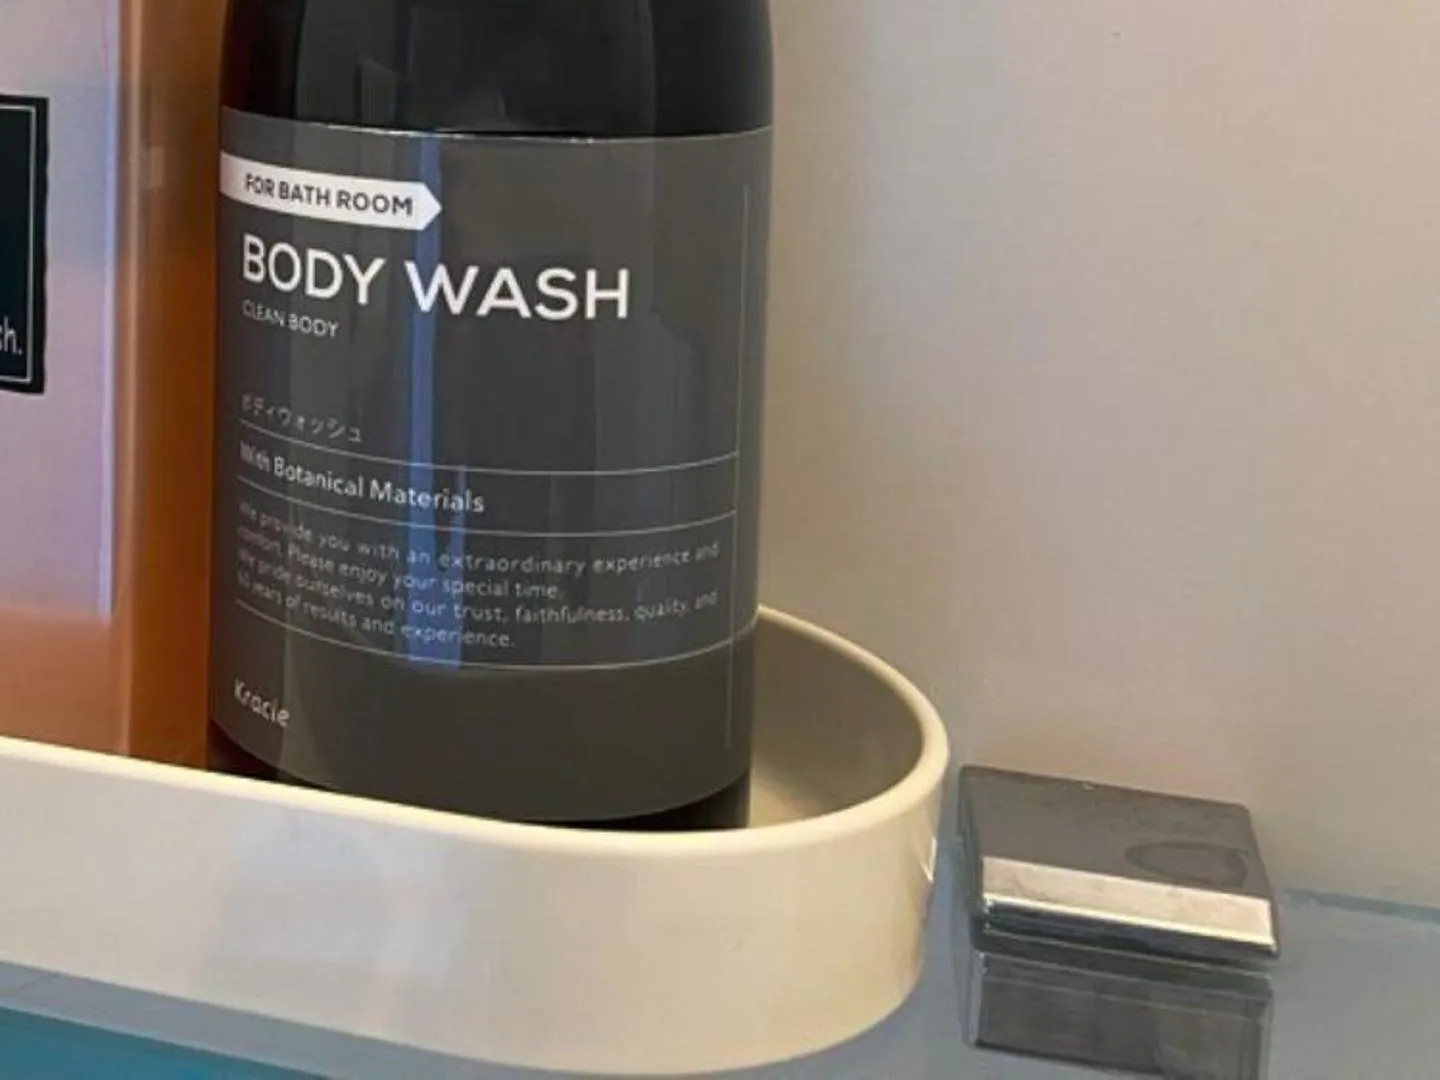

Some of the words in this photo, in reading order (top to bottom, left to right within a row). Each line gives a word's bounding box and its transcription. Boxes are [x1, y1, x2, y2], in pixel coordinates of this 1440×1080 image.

[244, 172, 275, 200] FOR
[278, 181, 331, 207] BATH
[337, 190, 413, 216] ROOM
[243, 234, 387, 305] BODY
[405, 260, 629, 319] WASH
[243, 299, 285, 329] CLEAN
[287, 312, 339, 338] BODY
[274, 456, 363, 497] Botanical
[370, 478, 485, 513] Materials
[288, 543, 335, 570] Please
[339, 563, 387, 586] enjoy
[393, 574, 435, 590] your
[444, 577, 509, 597] special
[319, 532, 350, 552] you
[357, 541, 399, 560] with
[407, 550, 430, 565] an
[440, 553, 585, 576] extraordinary
[592, 548, 690, 573] experience
[295, 574, 374, 606] ourselves
[381, 595, 405, 610] on
[412, 600, 446, 616] our
[303, 599, 356, 628] results
[361, 618, 394, 634] and
[234, 677, 290, 727] Kracie
